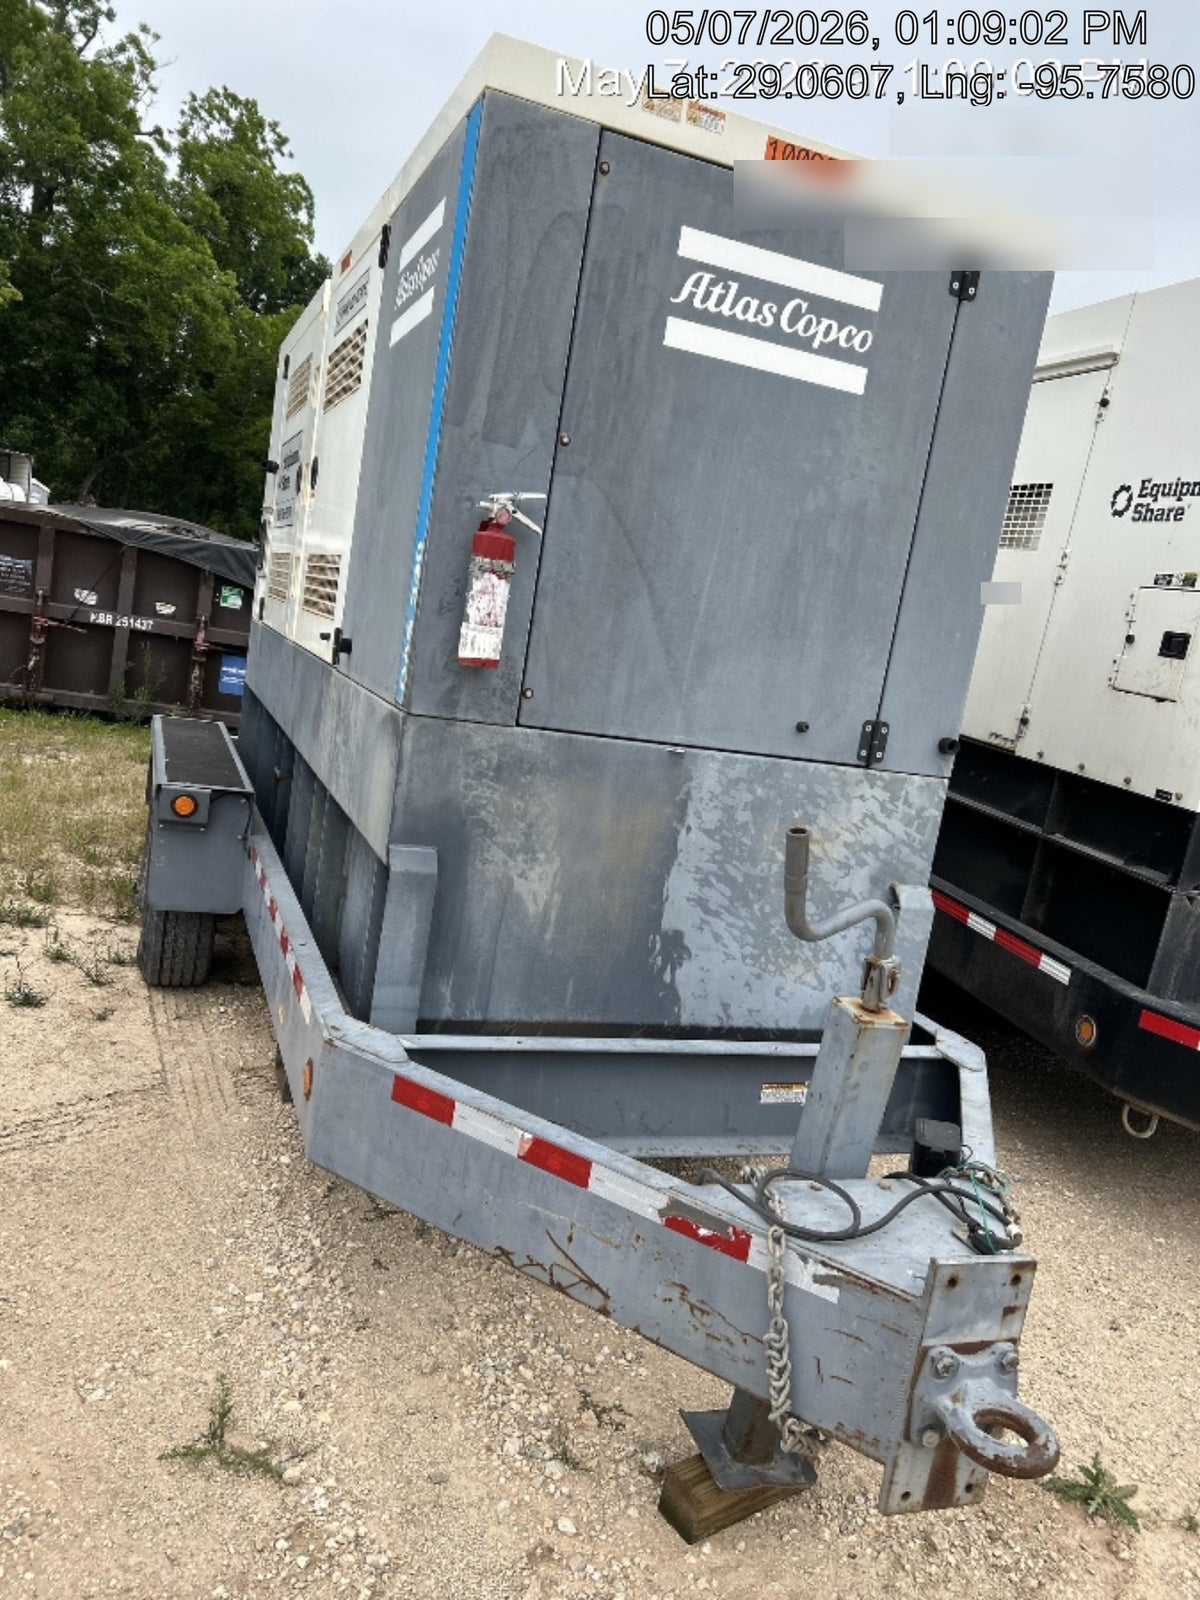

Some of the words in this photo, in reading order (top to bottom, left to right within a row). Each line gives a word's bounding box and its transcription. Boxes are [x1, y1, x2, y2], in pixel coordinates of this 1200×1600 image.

[670, 271, 778, 327] Atlas
[780, 298, 873, 353] Copco
[1131, 502, 1185, 521] Share
